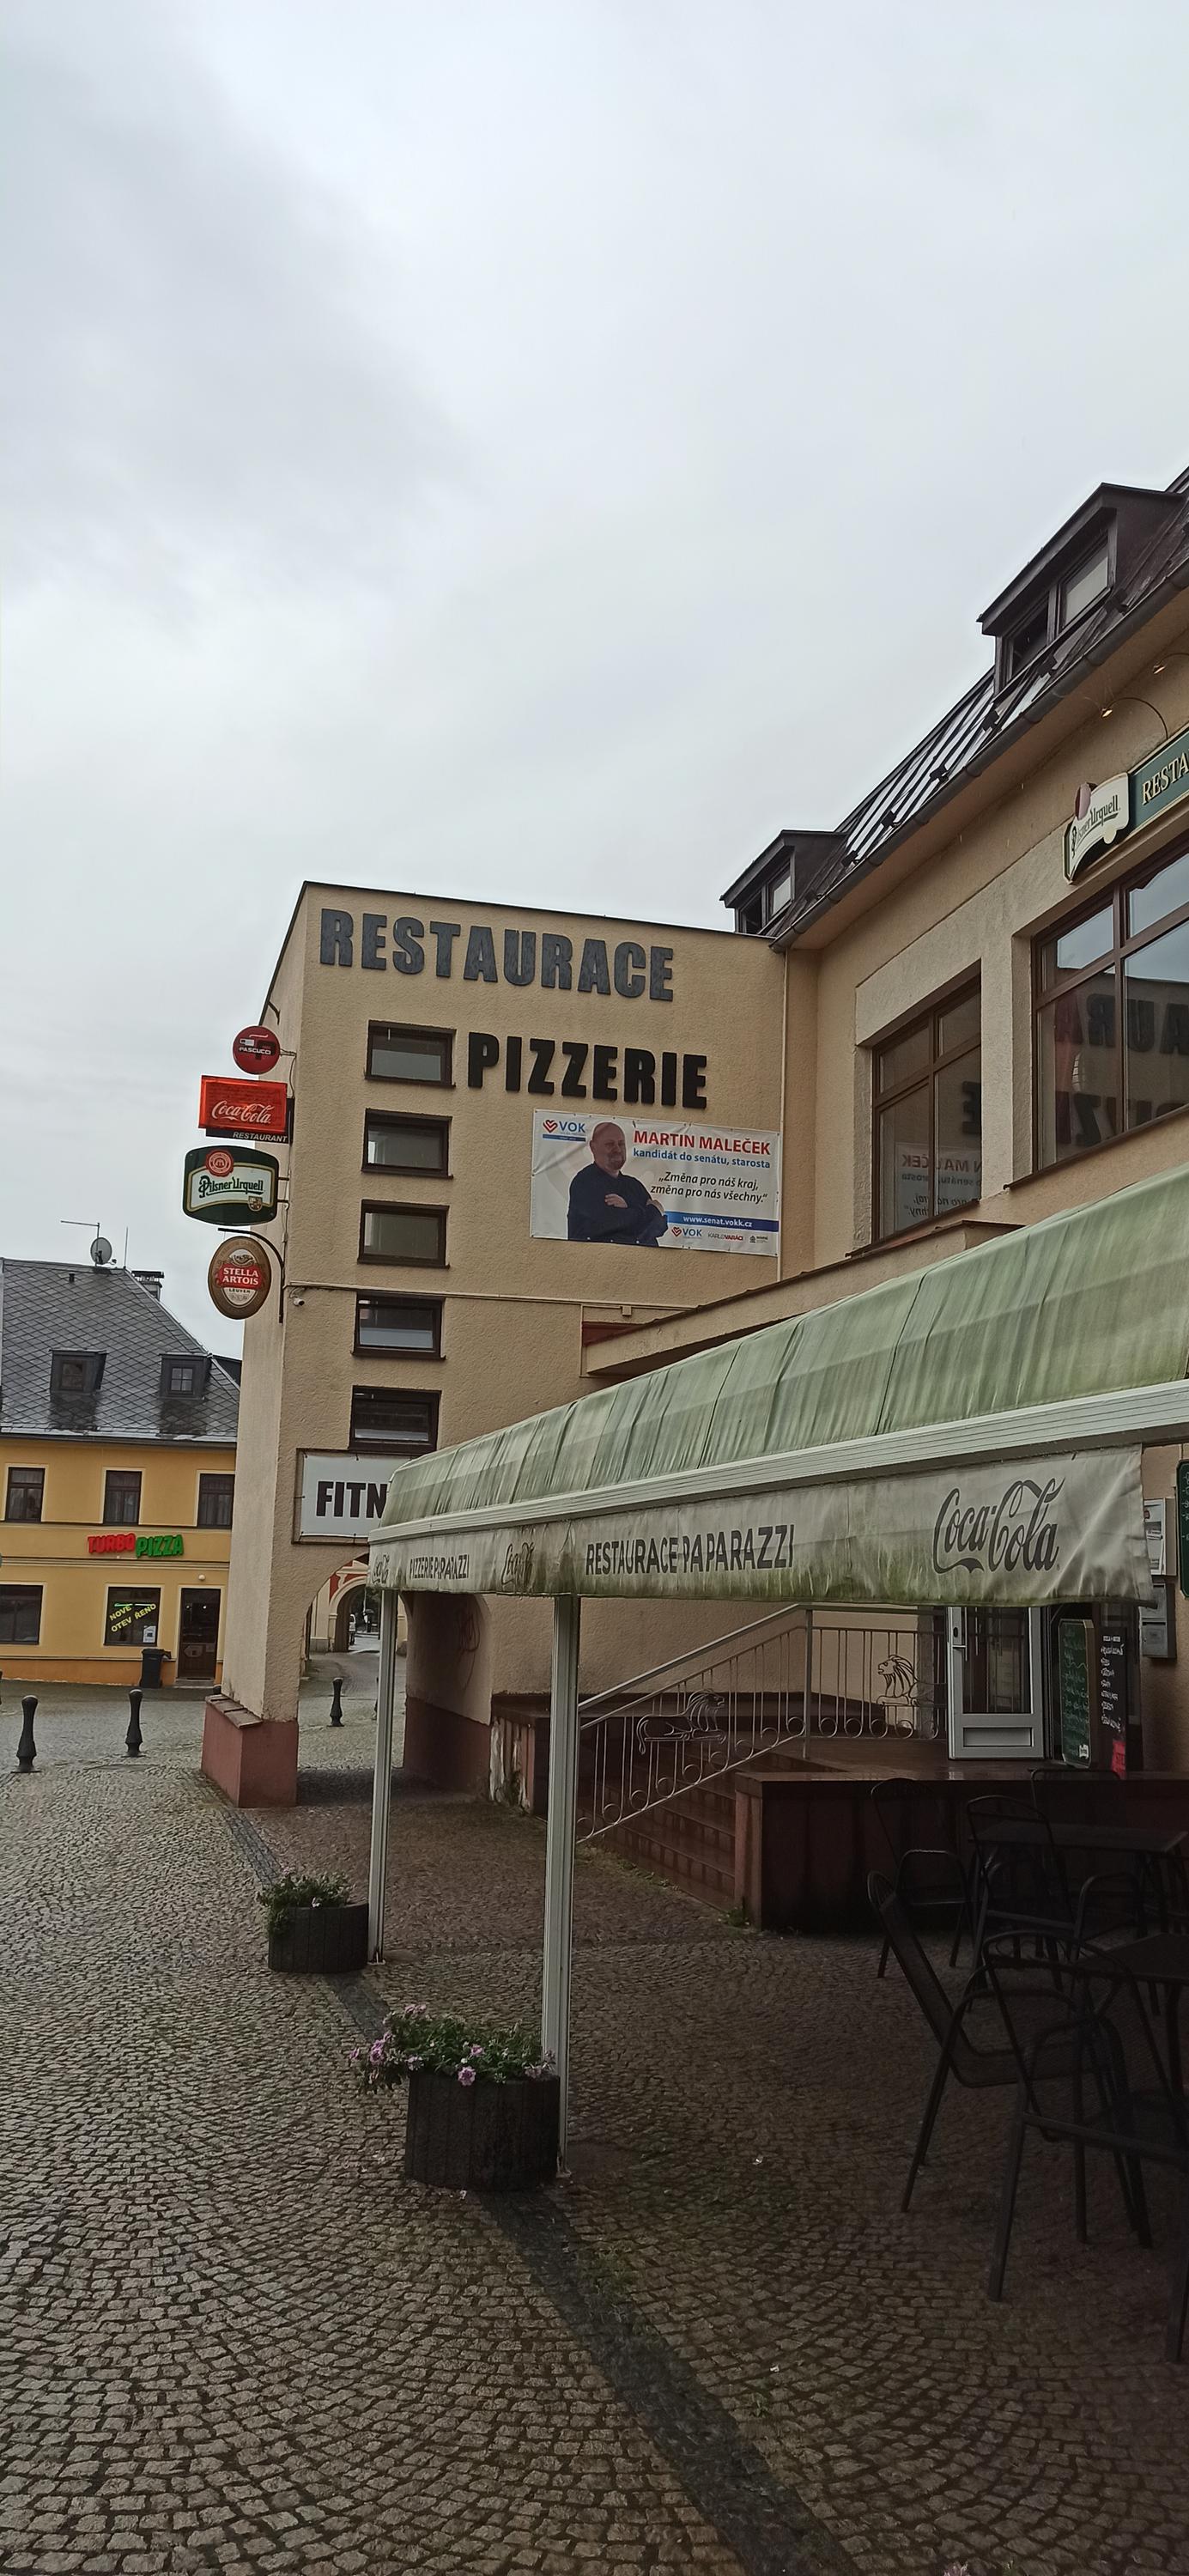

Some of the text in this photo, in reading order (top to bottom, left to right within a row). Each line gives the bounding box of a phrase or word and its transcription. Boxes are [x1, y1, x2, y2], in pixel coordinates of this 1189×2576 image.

[1142, 748, 1189, 805] RESTA
[1090, 794, 1119, 827] Urquell
[319, 908, 674, 1001] RESTAURACE
[466, 1031, 707, 1109] PIZZERIE
[211, 1100, 276, 1124] Coca-Cola
[233, 1131, 288, 1142] RESTAURANT
[559, 1121, 585, 1133] VOK
[634, 1130, 771, 1155] MARTIN MALEČEK
[633, 1148, 771, 1169] kandidát do senátu, starosta
[198, 1175, 264, 1199] Pilsner Urquell
[651, 1185, 683, 1195] změna
[685, 1188, 702, 1199] pro
[704, 1189, 721, 1200] nás
[700, 1176, 717, 1188] pro
[719, 1176, 736, 1188] náš
[737, 1178, 759, 1191] kraj,
[682, 1215, 753, 1228] www.senat.vokk.cz
[682, 1228, 703, 1237] VOK
[222, 1275, 258, 1285] ARTOIS
[223, 1267, 259, 1278] STELLA
[932, 1477, 1065, 1574] Coca-Cola
[88, 1533, 184, 1558] TURBO PIZZA
[585, 1524, 795, 1575] RESTAURACE PAPARAZZI
[111, 1616, 133, 1632] OTEV
